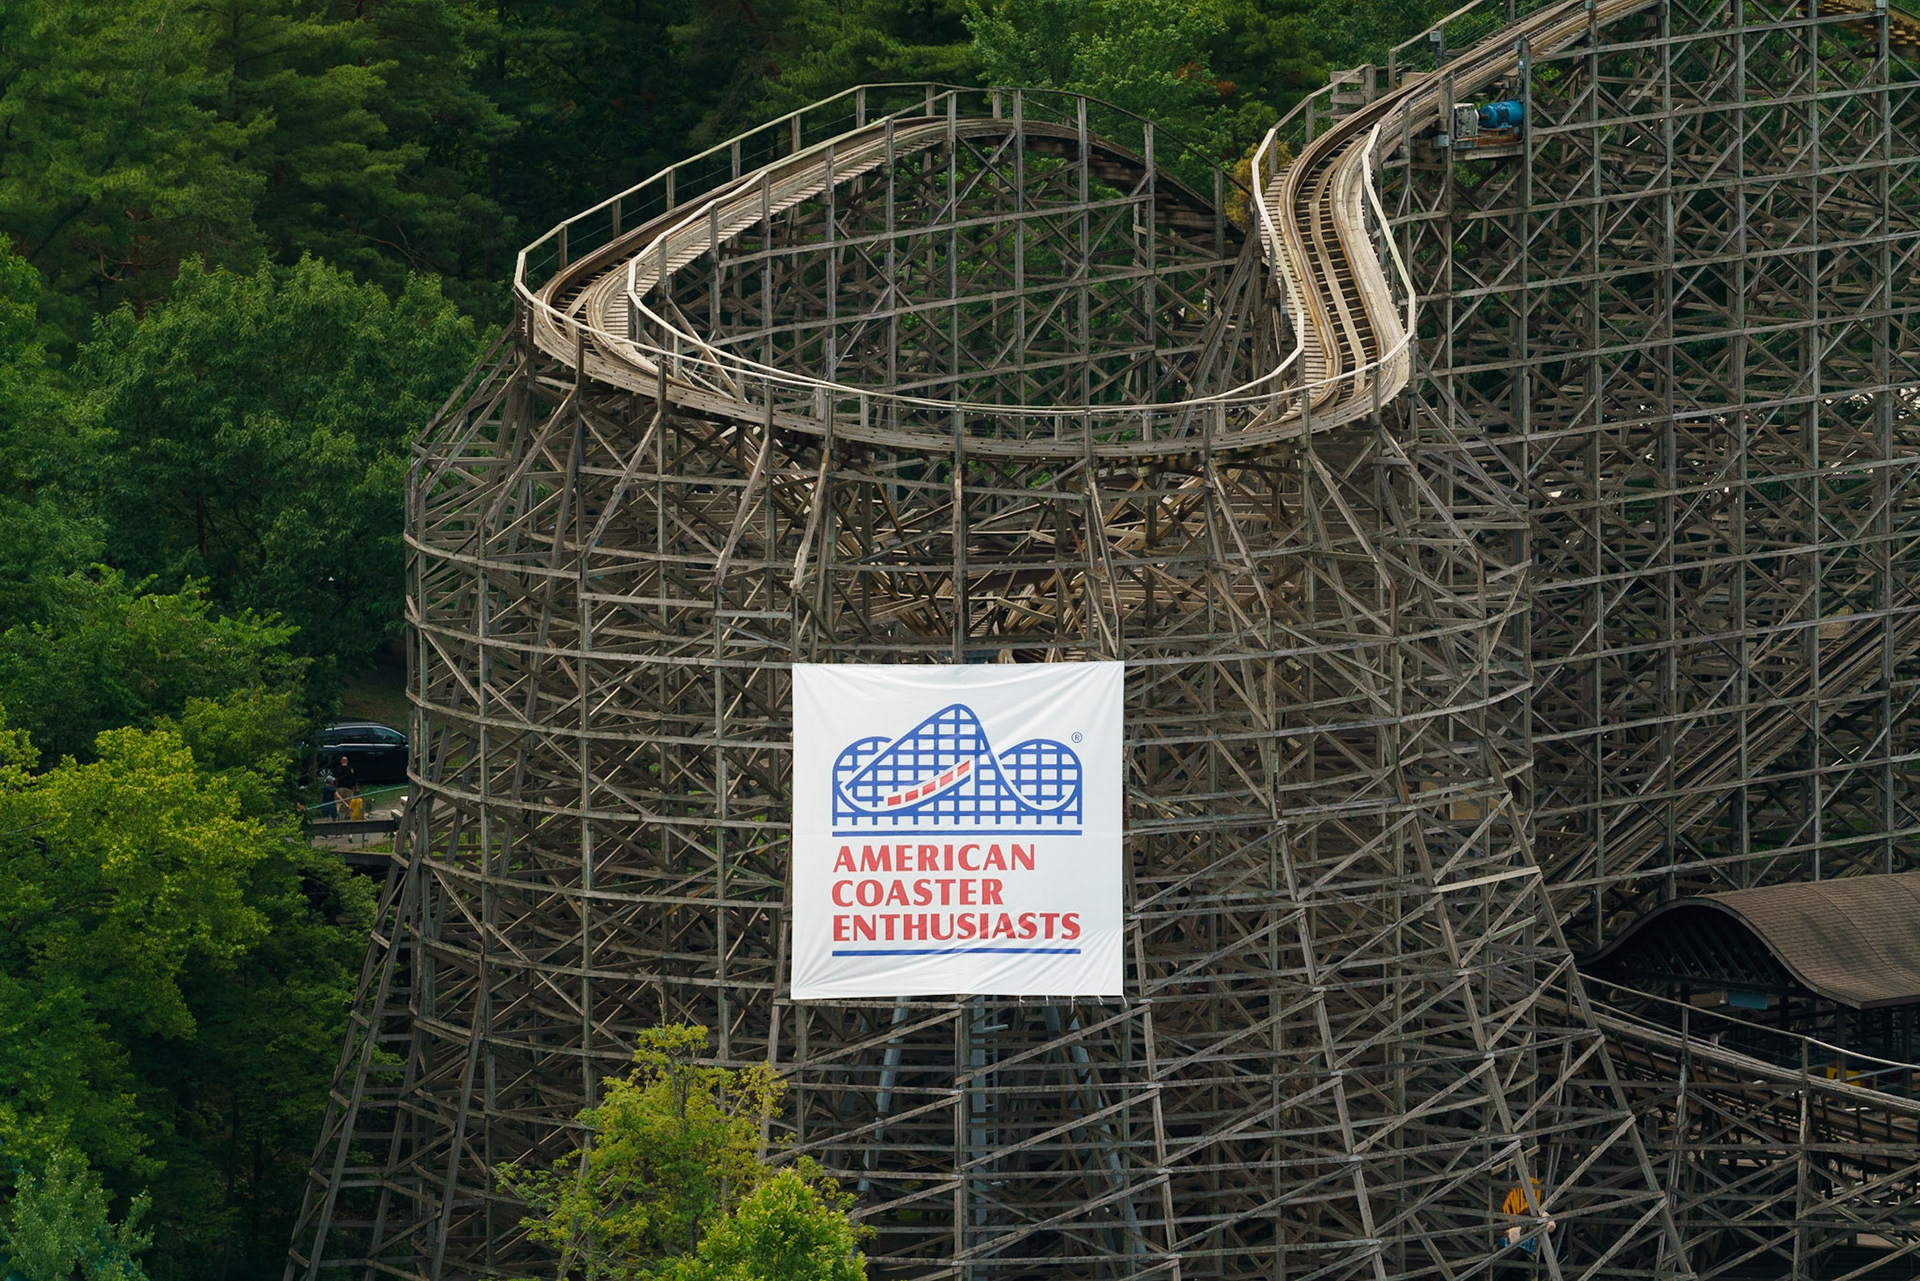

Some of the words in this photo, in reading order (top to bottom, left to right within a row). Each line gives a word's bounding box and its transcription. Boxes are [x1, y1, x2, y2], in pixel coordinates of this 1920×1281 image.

[833, 843, 1035, 873] AMERICAN
[832, 878, 1004, 907] COASTER
[833, 912, 1081, 942] ENTHUSIASTS
